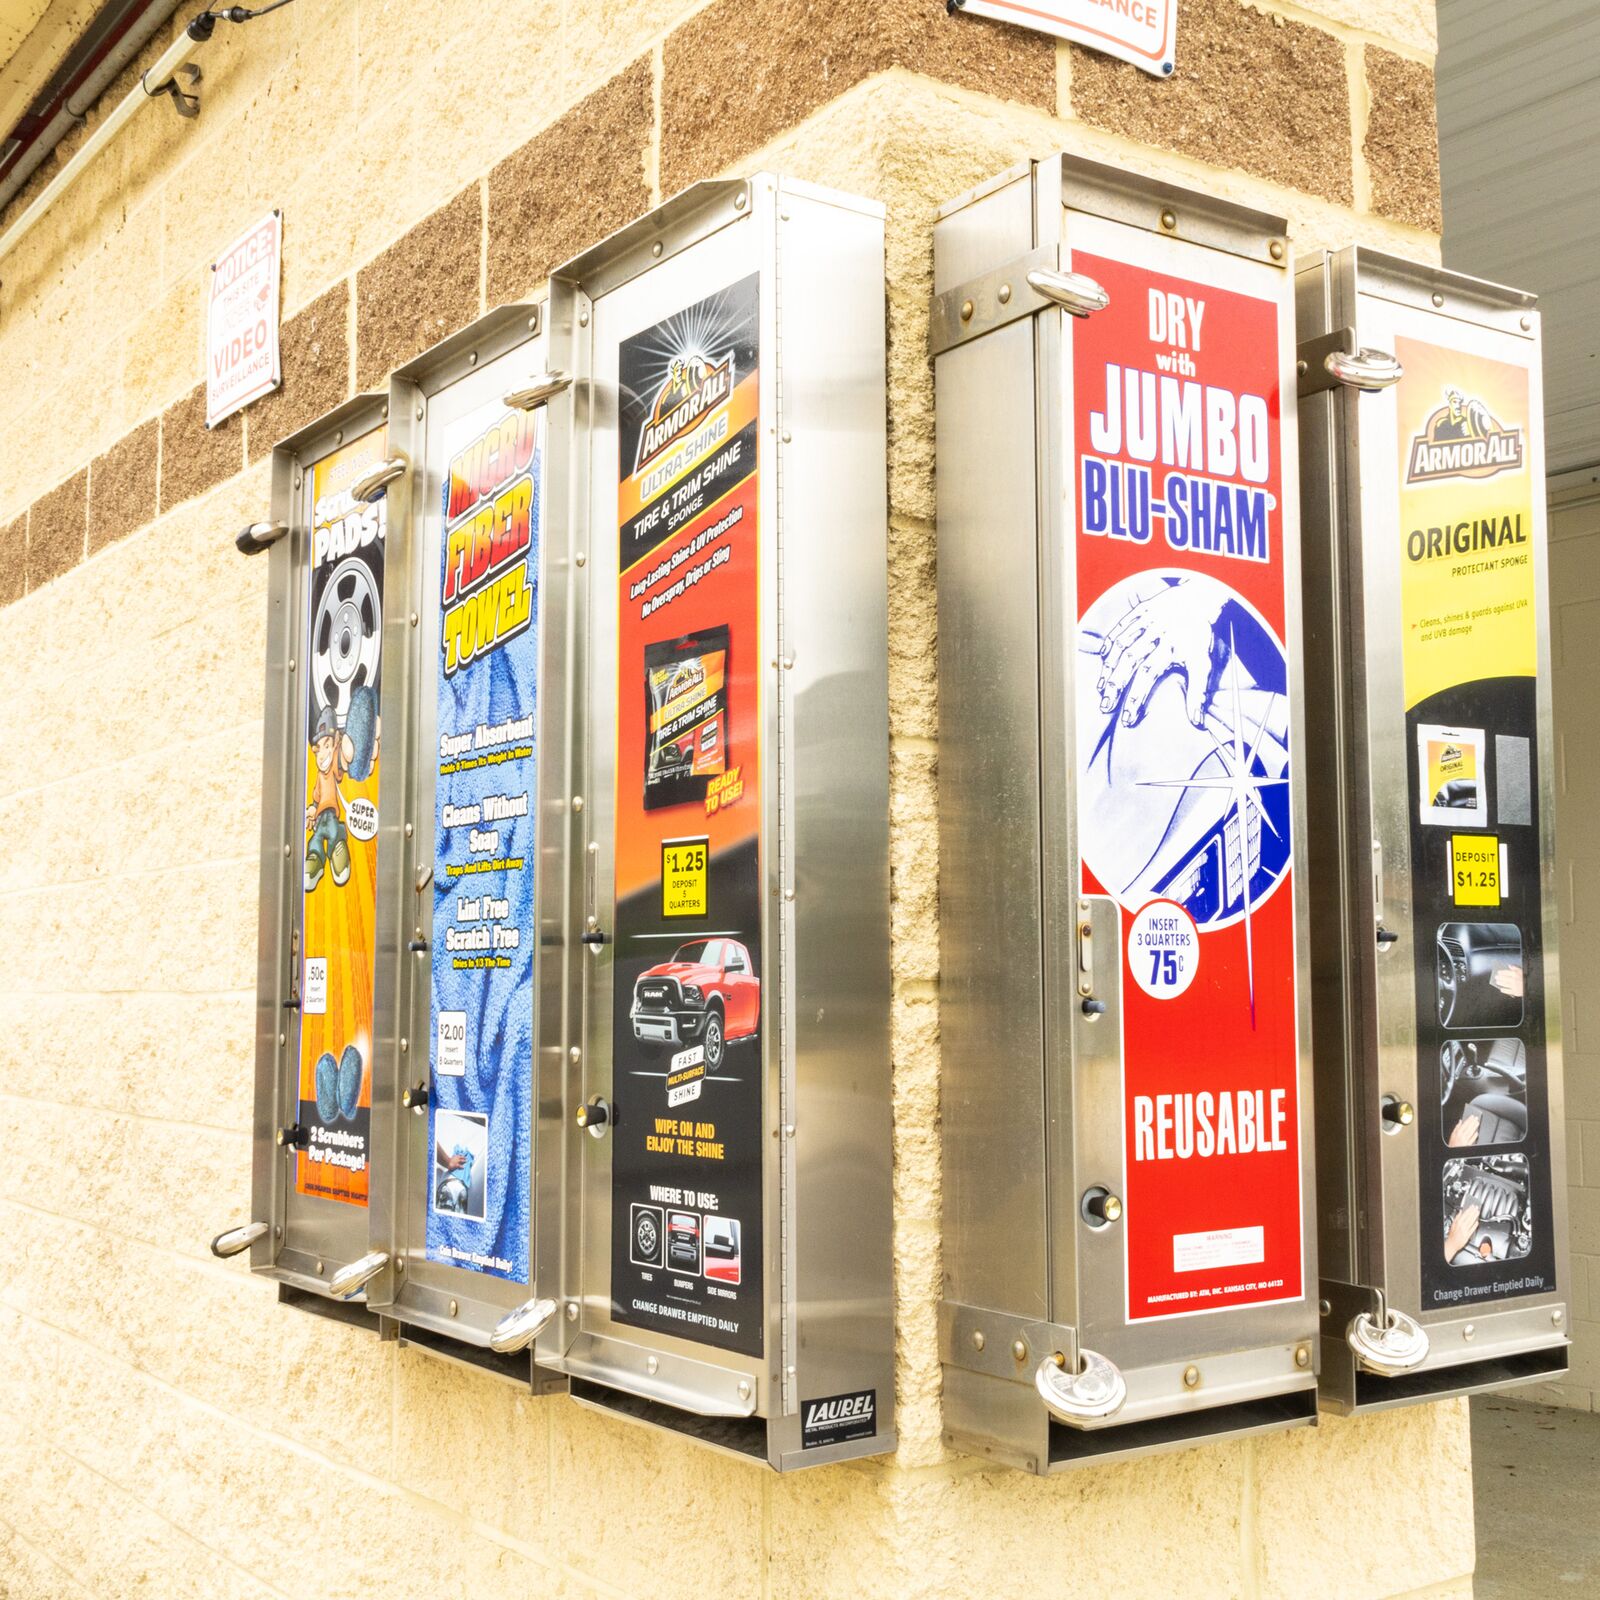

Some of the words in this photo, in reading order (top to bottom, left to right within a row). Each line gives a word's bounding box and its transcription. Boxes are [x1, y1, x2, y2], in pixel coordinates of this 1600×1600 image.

[1088, 0, 1157, 28] ANCE
[1148, 288, 1206, 352] DRY
[214, 318, 267, 379] VIDEO
[211, 352, 270, 402] SURVEILLANCE
[1155, 350, 1196, 377] with
[1089, 362, 1270, 483] JUMBO
[449, 409, 536, 520] MICRO
[641, 454, 682, 500] ULTRA
[685, 416, 728, 466] SHINE
[634, 508, 660, 540] TIRE
[661, 499, 670, 519] &
[672, 478, 701, 510] TRIM
[703, 441, 742, 487] SHINE
[667, 494, 704, 531] SPONGE
[1084, 458, 1267, 560] BLU-SHAM
[314, 497, 387, 568] PADS!
[445, 478, 531, 600] FIBER
[671, 546, 690, 569] Shine
[690, 538, 697, 556] &
[696, 531, 707, 551] UV
[706, 506, 743, 544] Protection
[1407, 513, 1527, 562] ORIGINAL
[1452, 560, 1499, 577] PROTECTANT
[1501, 555, 1528, 568] SPONGE
[641, 600, 651, 620] No
[686, 565, 704, 588] Drips
[703, 559, 713, 576] or
[712, 544, 731, 569] Sling
[446, 562, 531, 669] TOWEL
[1419, 617, 1442, 629] Cleans,
[1444, 613, 1464, 624] shines
[1465, 610, 1470, 619] &
[1471, 606, 1492, 620] guards
[1493, 602, 1515, 615] against
[1516, 599, 1528, 609] UVA
[1421, 631, 1432, 642] and
[1433, 628, 1447, 639] UVB
[1448, 624, 1472, 637] damage
[696, 695, 717, 718] SHINE
[441, 733, 473, 760] Super
[475, 713, 533, 750] Absorbent
[708, 765, 740, 797] READY
[705, 794, 719, 813] TO
[720, 779, 743, 805] USE!
[351, 803, 375, 819] SUPER
[443, 803, 481, 829] Cleans
[483, 791, 528, 822] Without
[349, 816, 375, 833] TOUGH!
[470, 828, 499, 856] Soap
[446, 863, 464, 878] Traps
[464, 861, 477, 874] And
[478, 859, 492, 873] Lifts
[493, 858, 505, 871] Dirt
[506, 857, 524, 871] Away
[666, 851, 704, 873] $1.25
[1455, 852, 1495, 863] DEPOSIT
[672, 879, 697, 889] DEPOSIT
[1457, 871, 1496, 887] $1.25
[669, 899, 701, 910] QUARTERS
[682, 889, 687, 898] 5
[457, 896, 480, 922] Lint
[482, 894, 509, 920] Free
[446, 925, 490, 952] Scratch
[493, 923, 519, 949] Free
[1149, 918, 1179, 931] INSERT
[1137, 933, 1143, 946] 3
[1145, 933, 1190, 946] QUARTERS
[440, 1024, 464, 1040] $2.00
[677, 1052, 698, 1067] FAST
[667, 1065, 704, 1086] MULTI-SURFACE
[673, 1085, 696, 1101] SHINE
[310, 1125, 317, 1142] 2
[318, 1127, 365, 1149] Scrubbers
[655, 1118, 678, 1135] WIPE
[679, 1120, 693, 1138] ON
[695, 1122, 715, 1140] AND
[1134, 1088, 1287, 1161] REUSABLE
[308, 1145, 325, 1162] Per
[325, 1148, 366, 1172] Package!
[646, 1136, 675, 1152] ENJOY
[677, 1138, 694, 1156] THE
[695, 1141, 724, 1160] SHINE
[650, 1185, 682, 1205] WHERE
[683, 1190, 696, 1207] TO
[697, 1192, 719, 1210] USE:
[641, 1272, 653, 1282] TIRES
[1434, 1289, 1463, 1301] Change
[1464, 1284, 1492, 1297] Drawer
[1493, 1278, 1524, 1293] Emptied
[1525, 1275, 1544, 1288] Daily
[707, 1286, 717, 1296] SIDE
[718, 1288, 737, 1300] MIRRORS
[632, 1298, 658, 1314] CHANGE
[659, 1304, 687, 1321] DRAWER
[687, 1312, 718, 1328] EMPTIED
[718, 1318, 739, 1334] DAILY
[805, 1395, 874, 1428] LAUREL
